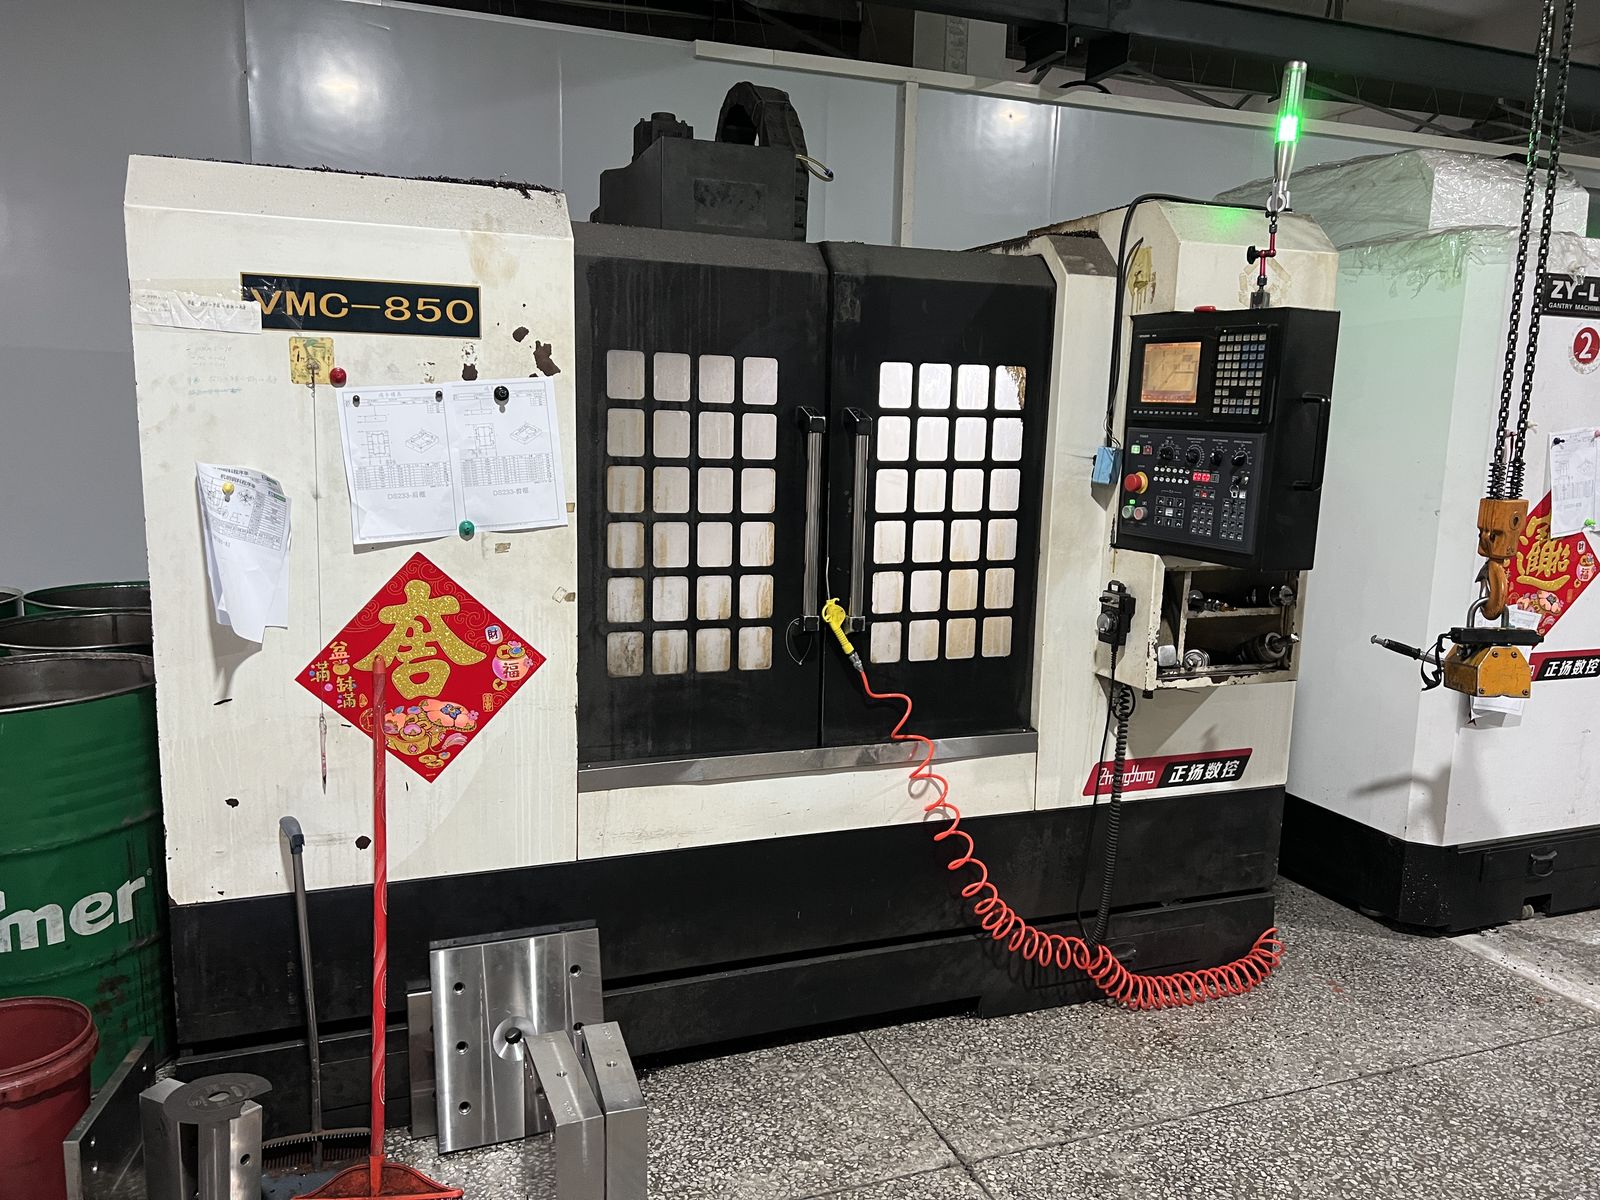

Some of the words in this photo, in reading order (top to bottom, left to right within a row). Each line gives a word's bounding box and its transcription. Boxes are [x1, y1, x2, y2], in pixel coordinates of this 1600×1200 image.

[250, 288, 475, 325] VMC-850
[1548, 302, 1573, 310] GANTRY
[1578, 331, 1593, 360] 2
[502, 662, 520, 679] 福
[1543, 657, 1600, 678] 正扬数控
[1168, 759, 1240, 784] 正扬数控
[0, 876, 146, 953] mer
